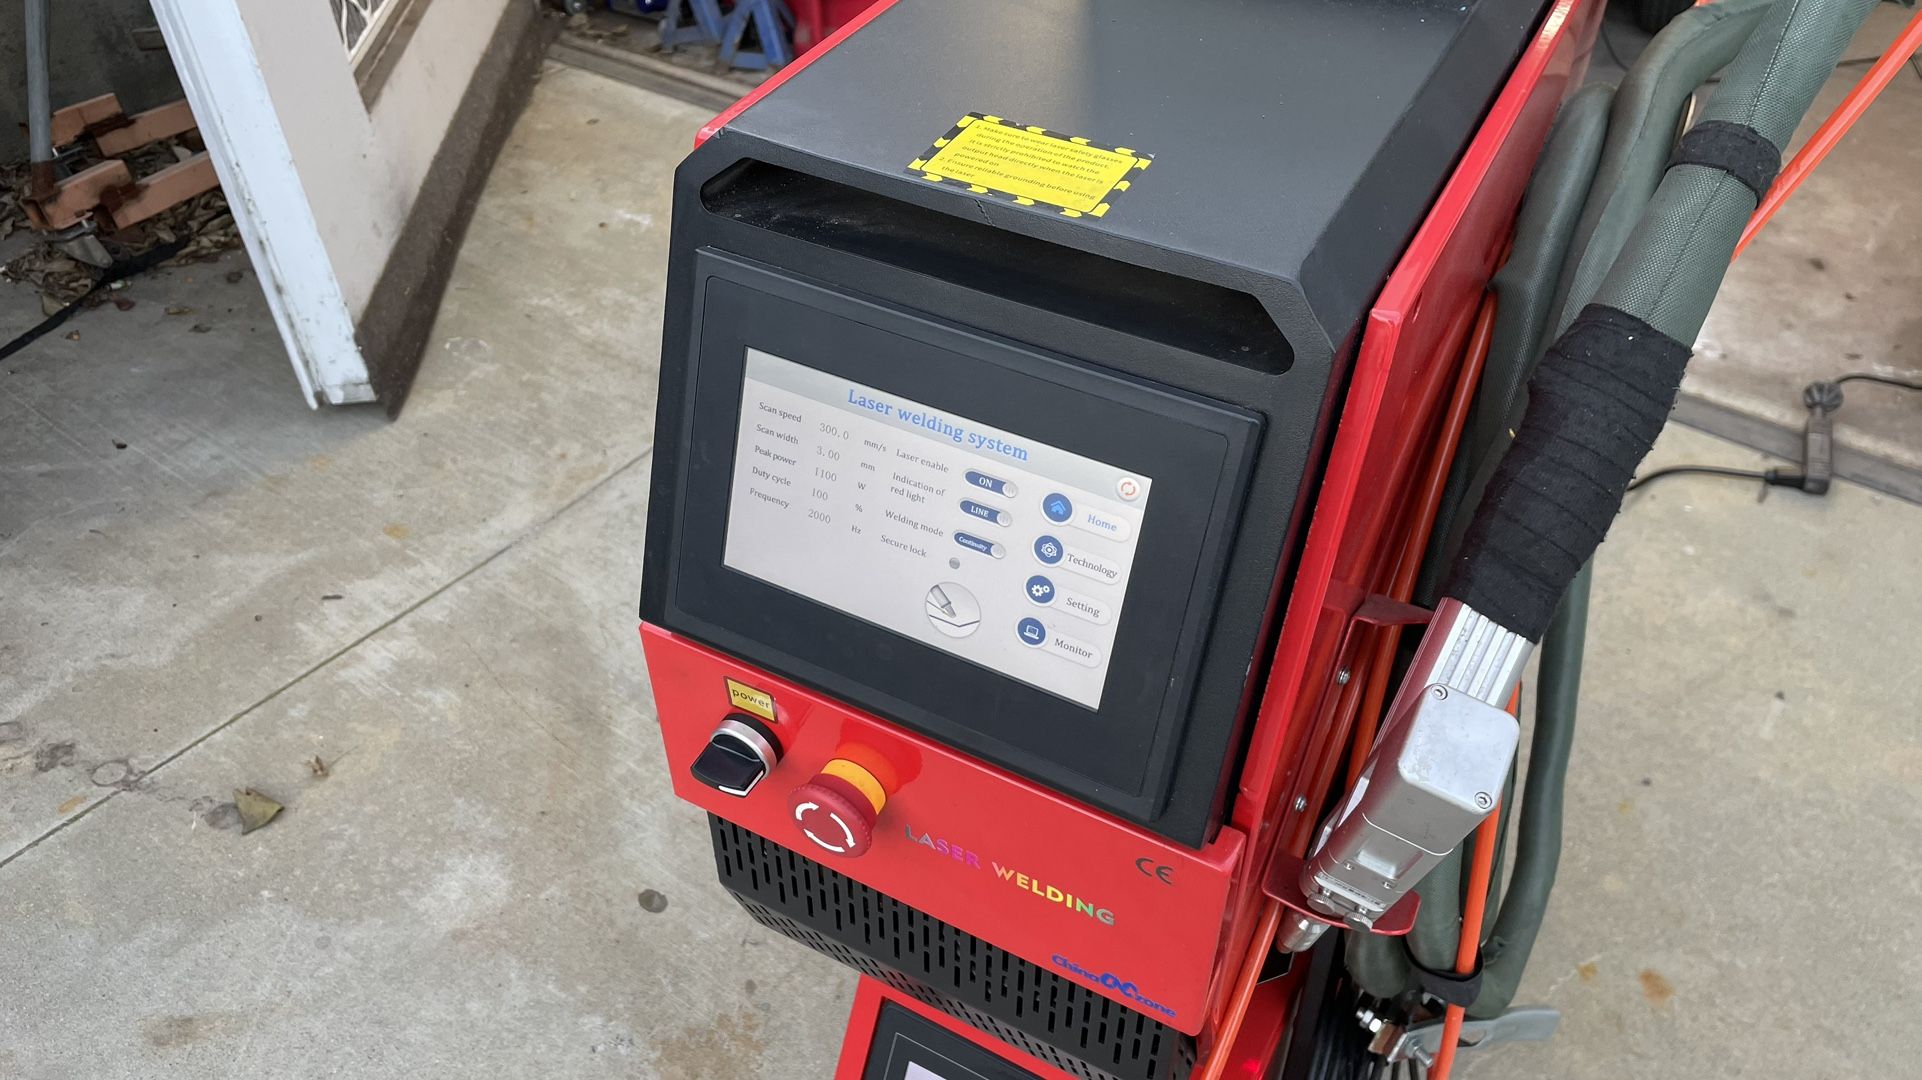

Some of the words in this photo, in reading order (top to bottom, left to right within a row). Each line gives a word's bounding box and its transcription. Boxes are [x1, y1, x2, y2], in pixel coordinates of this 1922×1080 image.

[976, 132, 1000, 143] during
[1015, 142, 1053, 155] operation
[984, 126, 1003, 135] Make
[1004, 131, 1020, 139] sure
[1030, 138, 1049, 146] wear
[1050, 142, 1070, 151] laser
[1070, 148, 1092, 158] safety
[1093, 152, 1123, 164] glasses
[953, 152, 990, 165] powered
[961, 145, 989, 156] output
[989, 151, 1008, 160] head
[1008, 157, 1038, 168] directly
[1039, 165, 1062, 174] when
[1075, 174, 1096, 183] laser
[984, 142, 1010, 153] strictly
[1010, 150, 1052, 164] prohibited
[1061, 162, 1086, 171] watch
[1086, 167, 1100, 175] the
[947, 158, 974, 169] Ensure
[975, 166, 1004, 177] reliable
[1003, 172, 1046, 188] grounding
[1046, 183, 1073, 194] before
[1073, 190, 1096, 200] using
[955, 169, 976, 178] laser
[758, 401, 777, 416] Scan
[778, 408, 802, 424] speed
[756, 423, 775, 438] Scan
[776, 430, 799, 446] width
[819, 423, 850, 440] 300.0
[848, 388, 893, 416] Laser
[898, 408, 965, 443] welding
[967, 431, 1029, 462] system
[754, 444, 772, 458] Peak
[772, 452, 797, 467] power
[816, 445, 841, 461] 3.00
[863, 438, 888, 453] mm/s
[860, 461, 876, 472] mm
[896, 448, 920, 464] Laser
[920, 458, 950, 474] enable
[752, 466, 770, 482] Duty
[770, 473, 792, 488] cycle
[814, 466, 838, 482] 1100
[892, 471, 935, 495] Indication
[936, 488, 946, 497] of
[979, 477, 993, 489] ON
[811, 488, 829, 502] 100
[857, 482, 866, 490] W
[890, 485, 906, 497] red
[906, 489, 926, 504] light
[749, 486, 790, 510] Frequency
[855, 504, 863, 513] %
[807, 508, 832, 524] 2000
[970, 504, 990, 518] LINE
[851, 525, 862, 534] Hz
[884, 508, 920, 530] Welding
[920, 523, 945, 538] mode
[1087, 513, 1118, 533] Home
[880, 534, 908, 551] Secure
[909, 544, 928, 558] lock
[958, 535, 988, 552] Continuity
[1067, 552, 1118, 580] Technology
[1066, 597, 1101, 620] Setting
[1054, 637, 1094, 660] Monitor
[731, 687, 771, 710] power
[905, 823, 982, 870] LASER
[991, 861, 1117, 926] WELDING
[1135, 857, 1175, 886] CE
